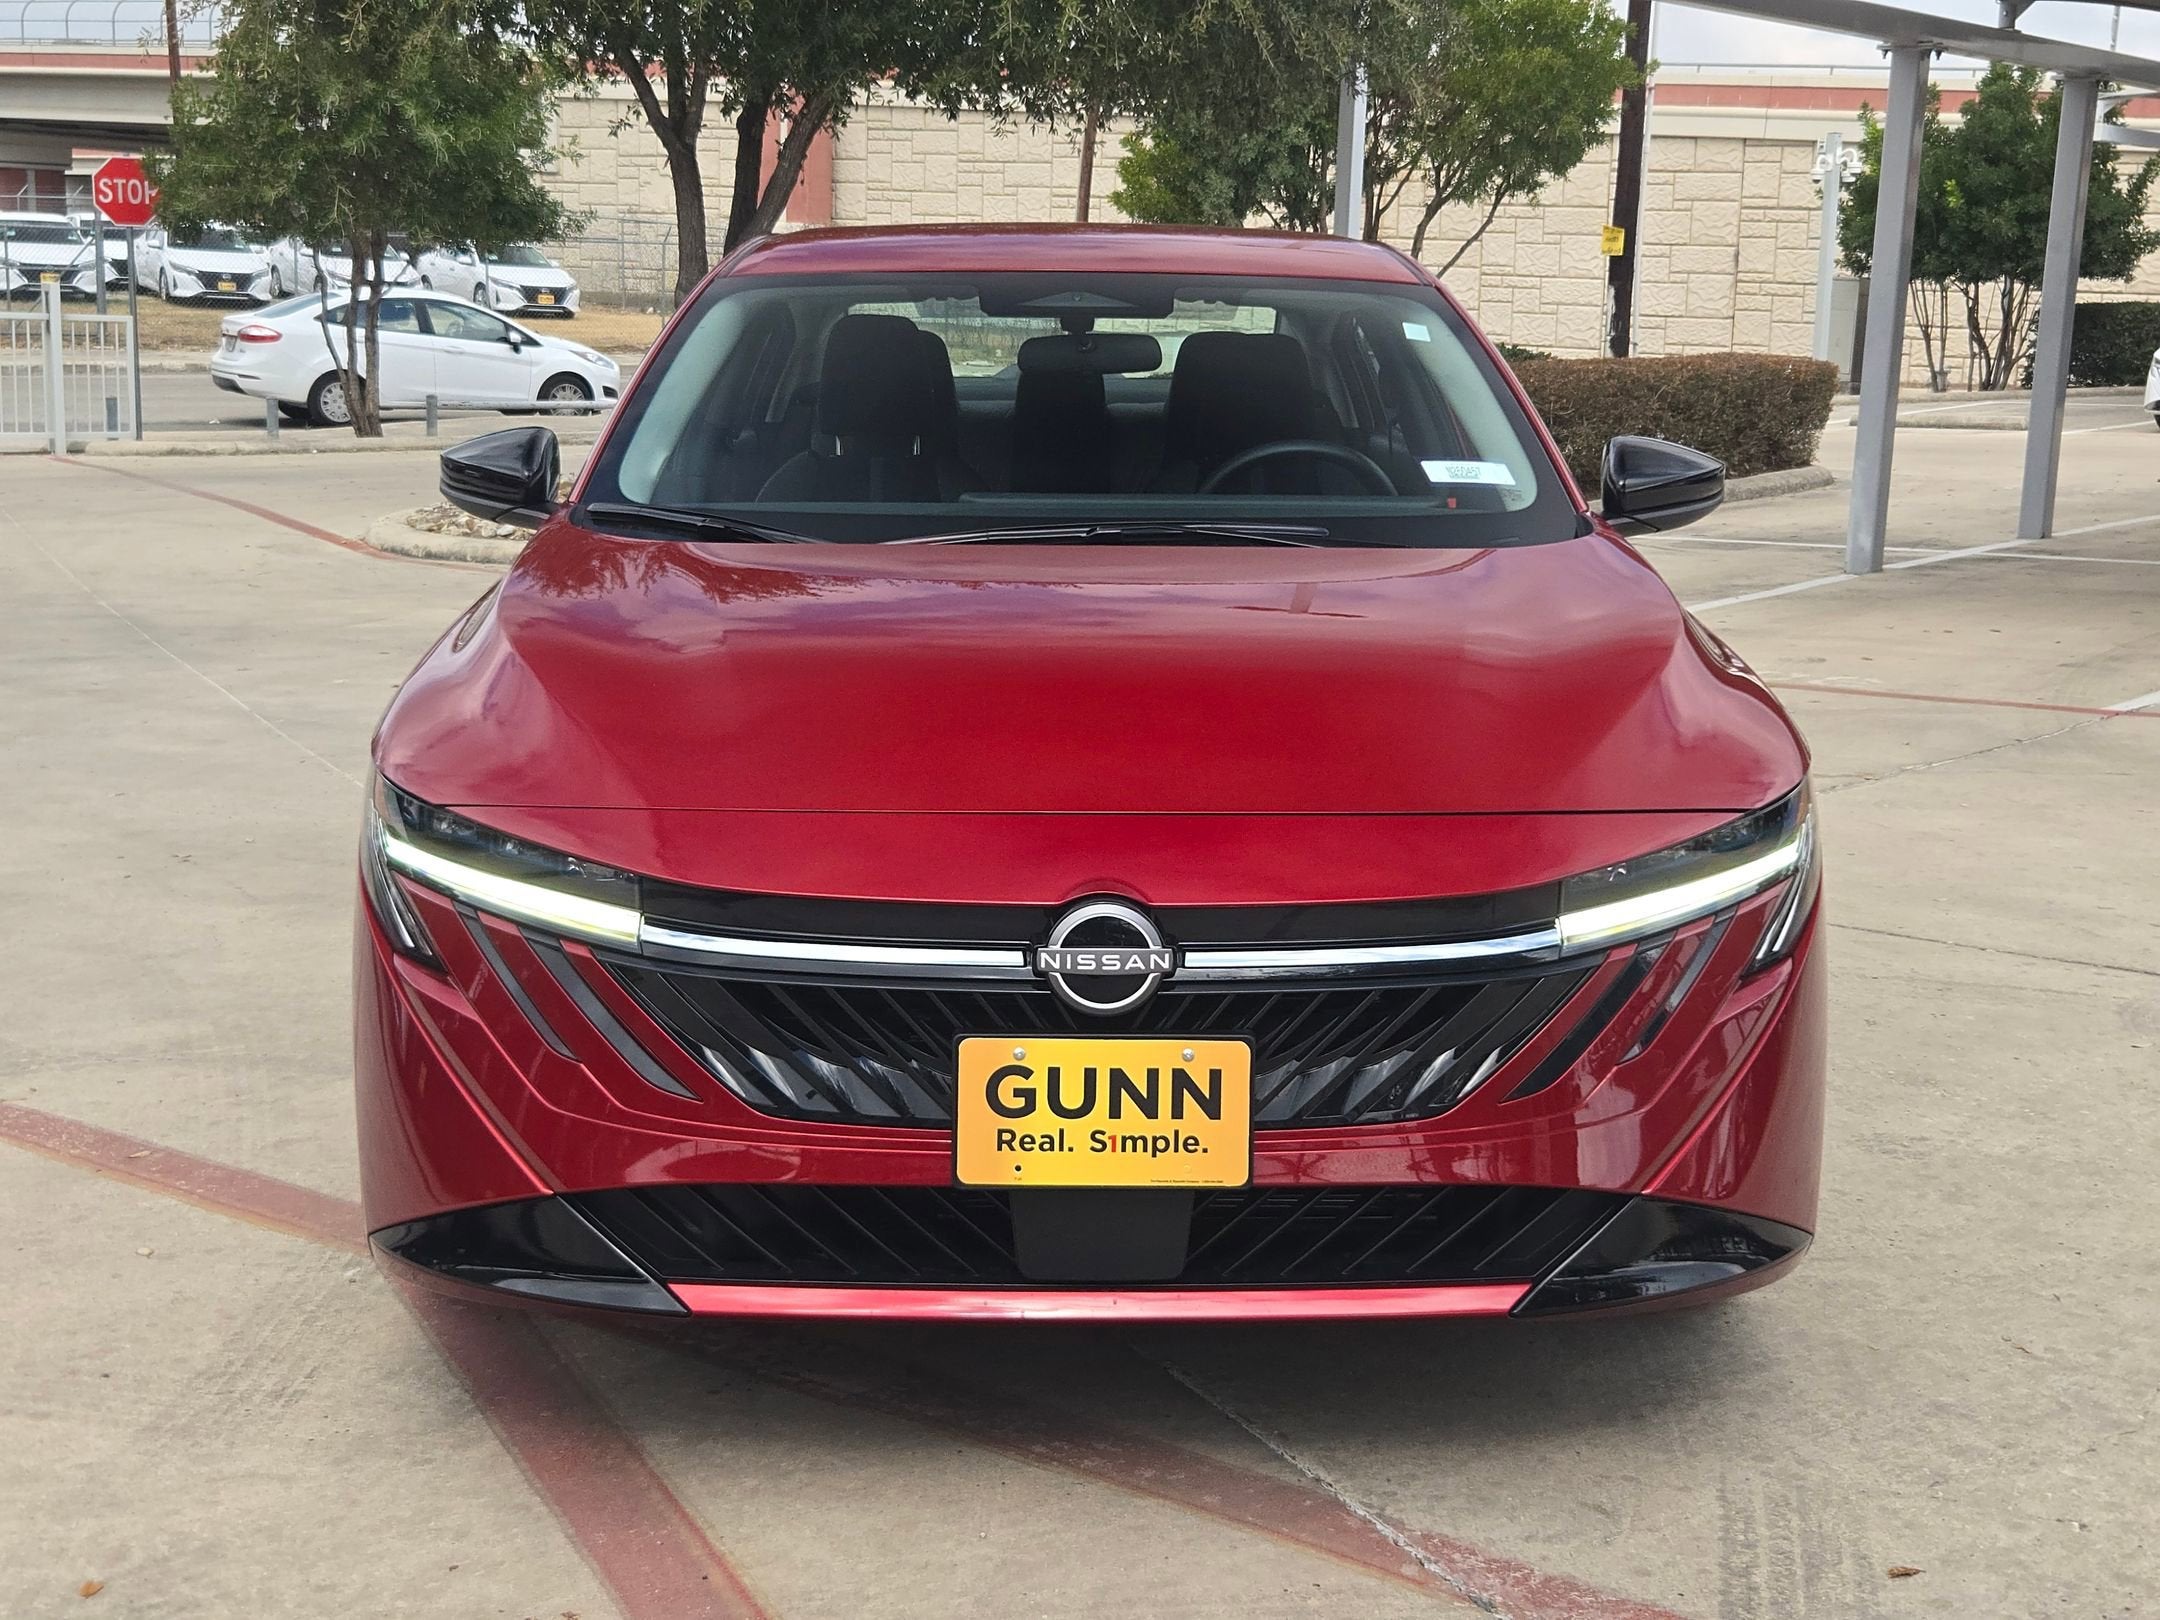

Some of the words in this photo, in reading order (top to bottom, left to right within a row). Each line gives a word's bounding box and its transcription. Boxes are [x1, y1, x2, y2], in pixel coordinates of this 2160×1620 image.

[1040, 953, 1170, 970] NISSAN
[985, 1065, 1222, 1120] GUNN
[997, 1128, 1074, 1152] Real.
[1090, 1130, 1208, 1158] S1mple.
